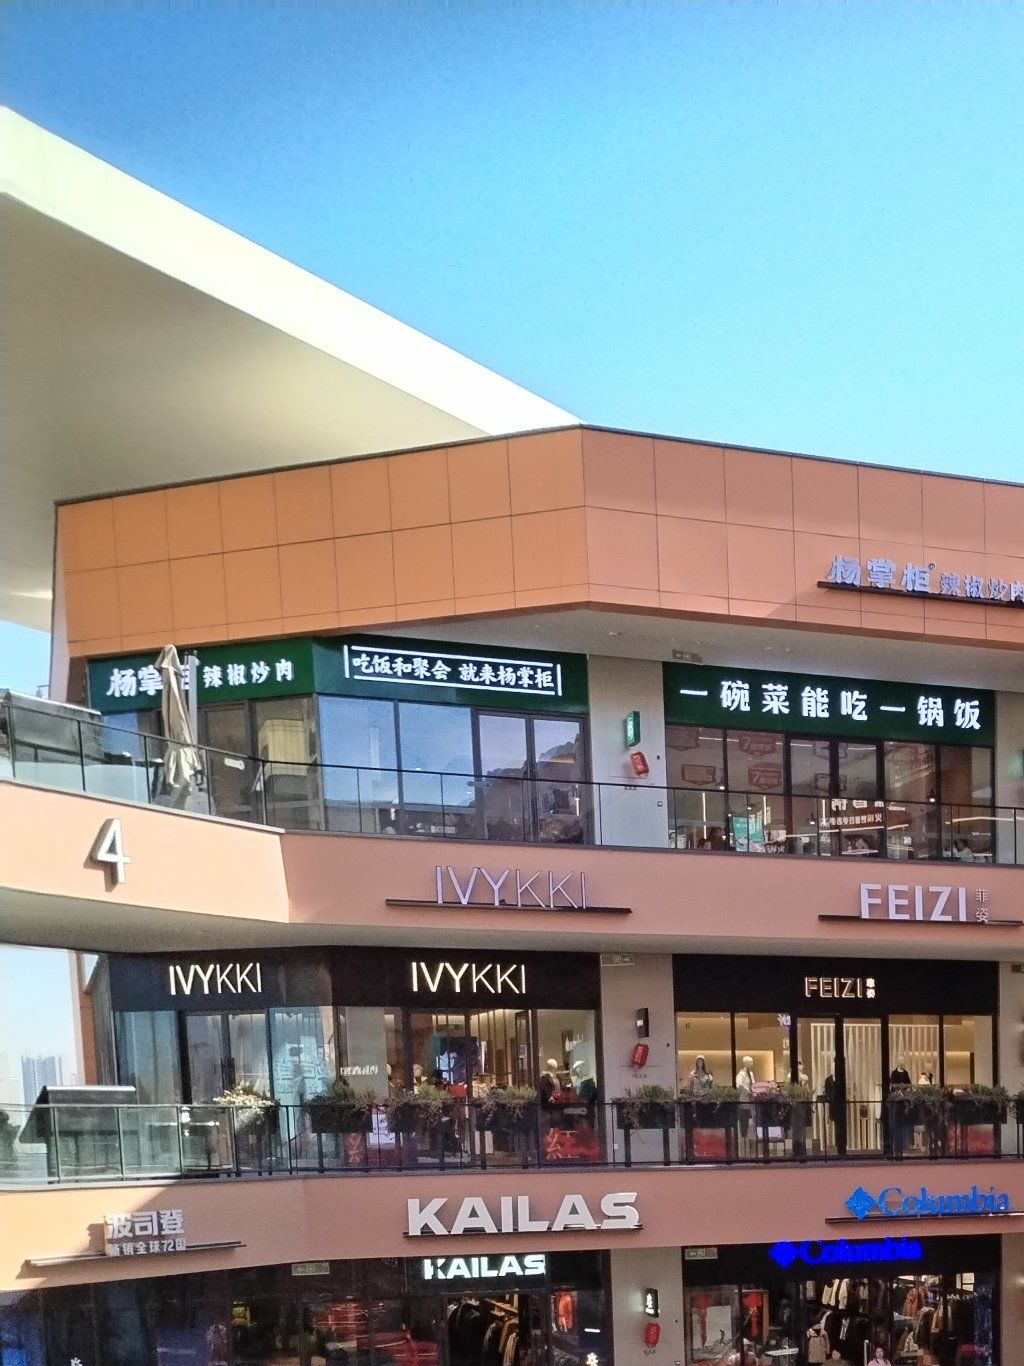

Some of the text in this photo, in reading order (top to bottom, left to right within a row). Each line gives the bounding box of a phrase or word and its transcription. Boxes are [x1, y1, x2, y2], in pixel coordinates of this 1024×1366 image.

[827, 555, 931, 593] 杨掌柜
[203, 658, 295, 689] 辣椒炒肉
[352, 652, 555, 689] 吃饭和聚会 就来杨掌柜
[679, 679, 982, 731] 一碗菜能吃一锅饭
[93, 818, 132, 885] 4
[435, 865, 587, 909] IVYKKI
[860, 882, 990, 923] FEIZI 菲姿
[168, 962, 262, 995] IVYKKI
[411, 961, 527, 994] IVYKKI
[804, 976, 863, 998] FEIZI
[407, 1191, 641, 1236] KAILAS
[877, 1185, 1010, 1216] Columbia
[107, 1208, 185, 1239] 波司登
[799, 1235, 923, 1264] Columbia
[423, 1253, 547, 1280] KAILAS
